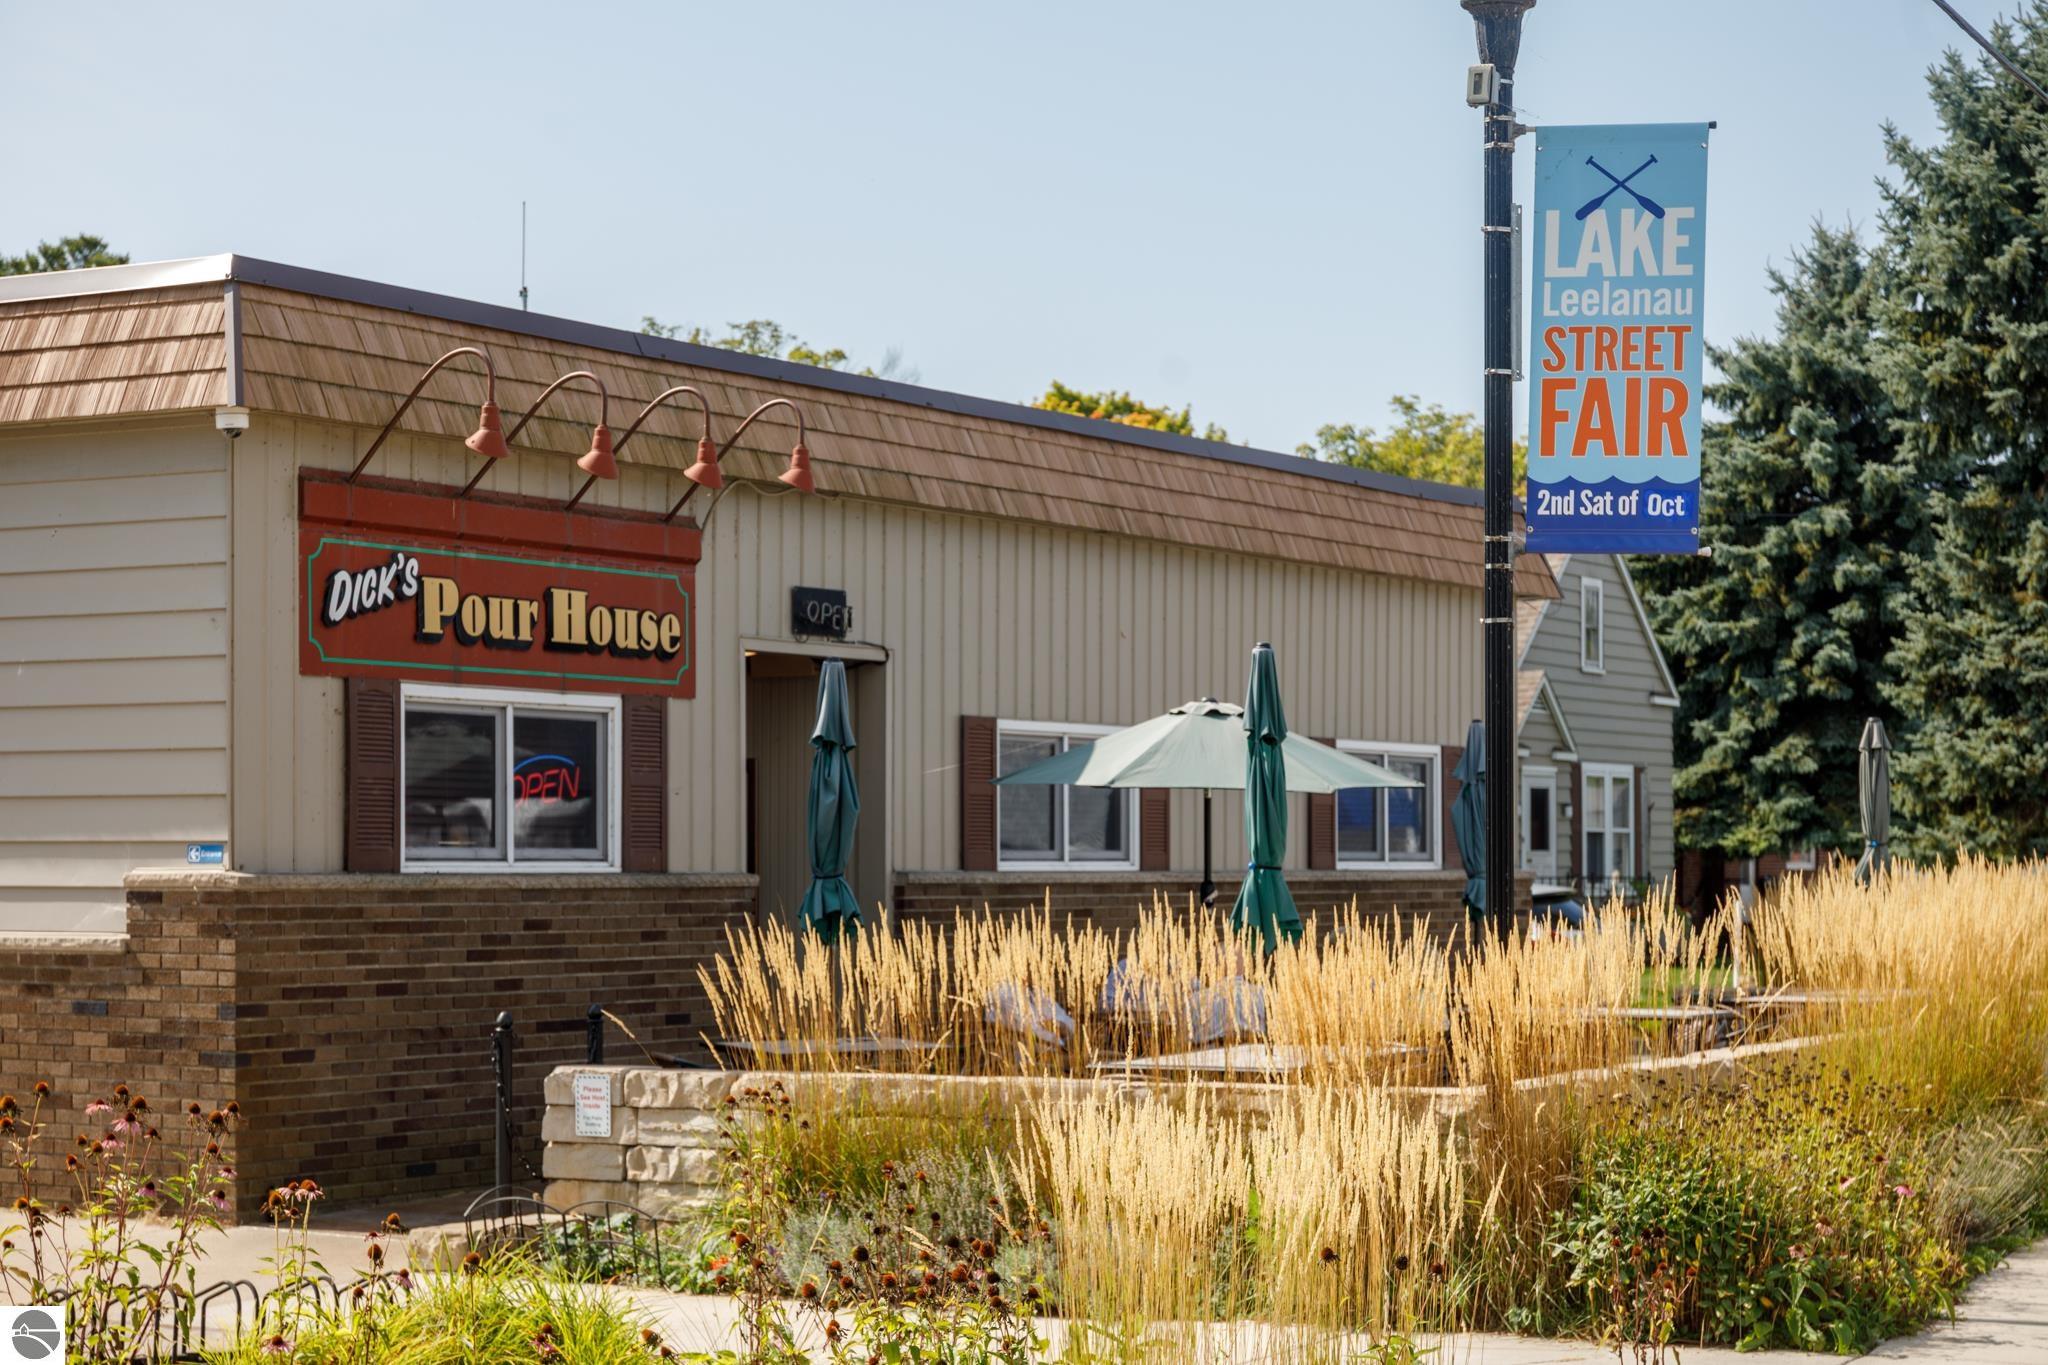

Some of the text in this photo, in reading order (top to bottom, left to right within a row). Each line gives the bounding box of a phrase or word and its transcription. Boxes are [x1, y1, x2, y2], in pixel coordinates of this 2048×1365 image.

[1544, 206, 1696, 278] LAKE
[1542, 280, 1694, 317] Leelanau
[1541, 325, 1694, 373] STREET
[1538, 376, 1690, 458] FAIR
[1537, 489, 1686, 517] 2nd Sat of Oct
[323, 551, 682, 661] DICK'S Pour House
[807, 600, 842, 630] OPE
